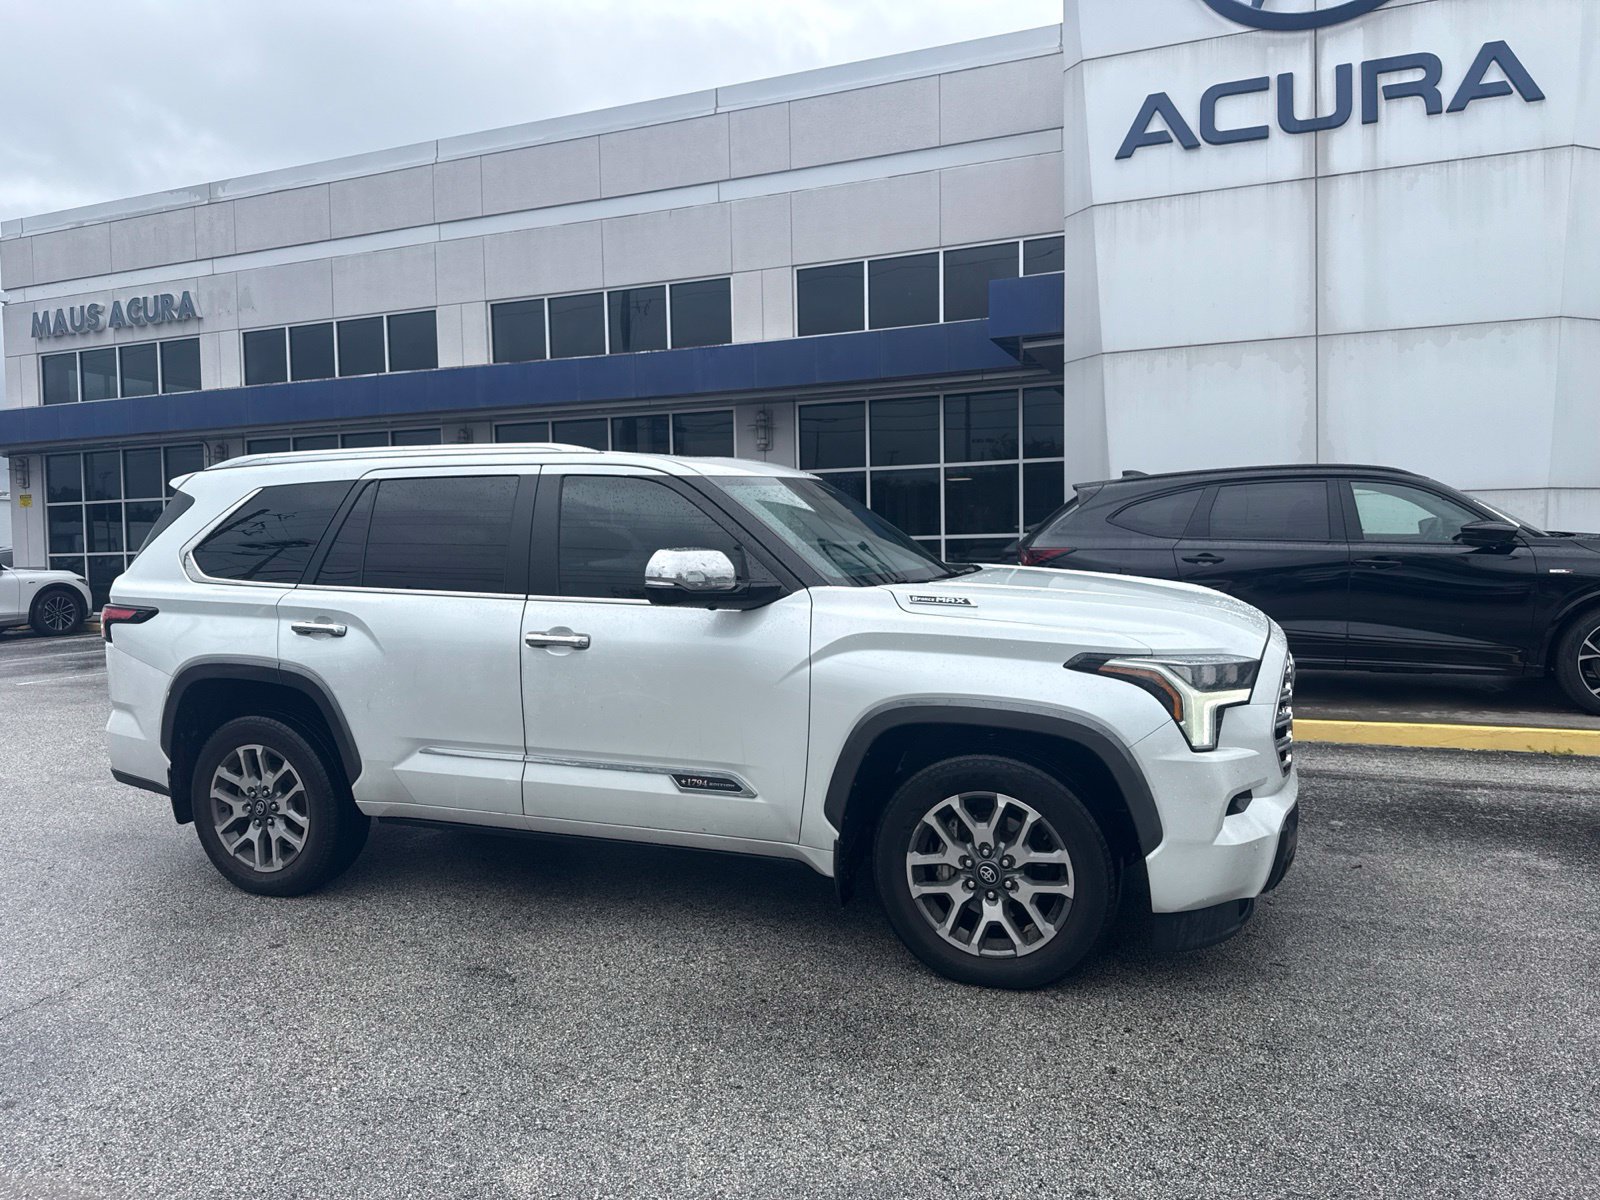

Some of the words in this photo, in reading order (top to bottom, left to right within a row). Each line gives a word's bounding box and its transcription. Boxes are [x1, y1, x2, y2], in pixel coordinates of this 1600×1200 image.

[1114, 39, 1545, 160] ACURA
[31, 303, 104, 338] MAUS
[108, 290, 200, 329] ACURA
[687, 778, 708, 787] 1794
